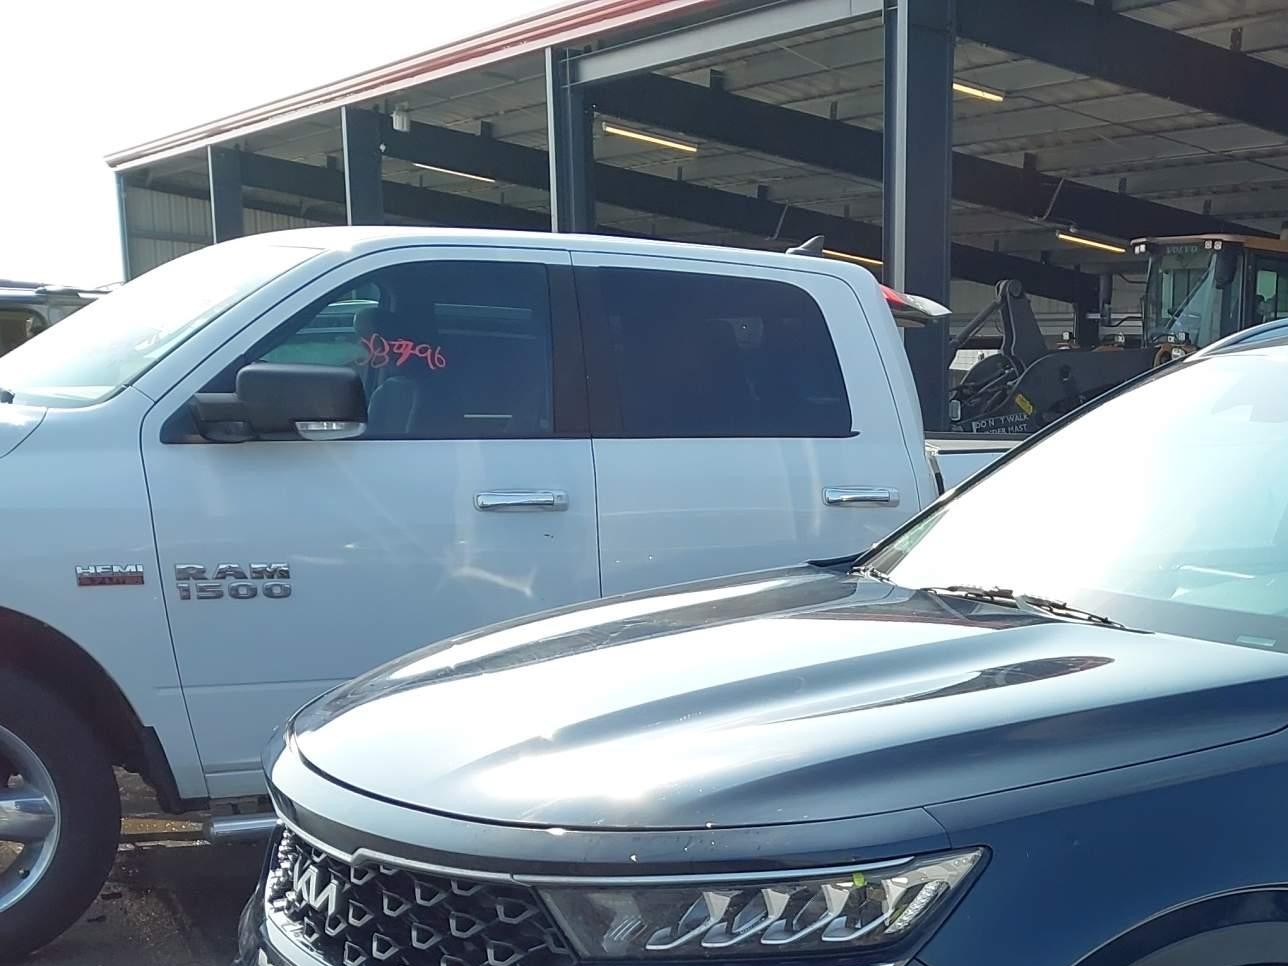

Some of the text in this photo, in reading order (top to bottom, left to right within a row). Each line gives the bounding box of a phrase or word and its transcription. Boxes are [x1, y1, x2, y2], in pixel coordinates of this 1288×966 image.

[75, 564, 144, 574] HEMI
[175, 563, 291, 581] RAM
[176, 582, 292, 600] 1500
